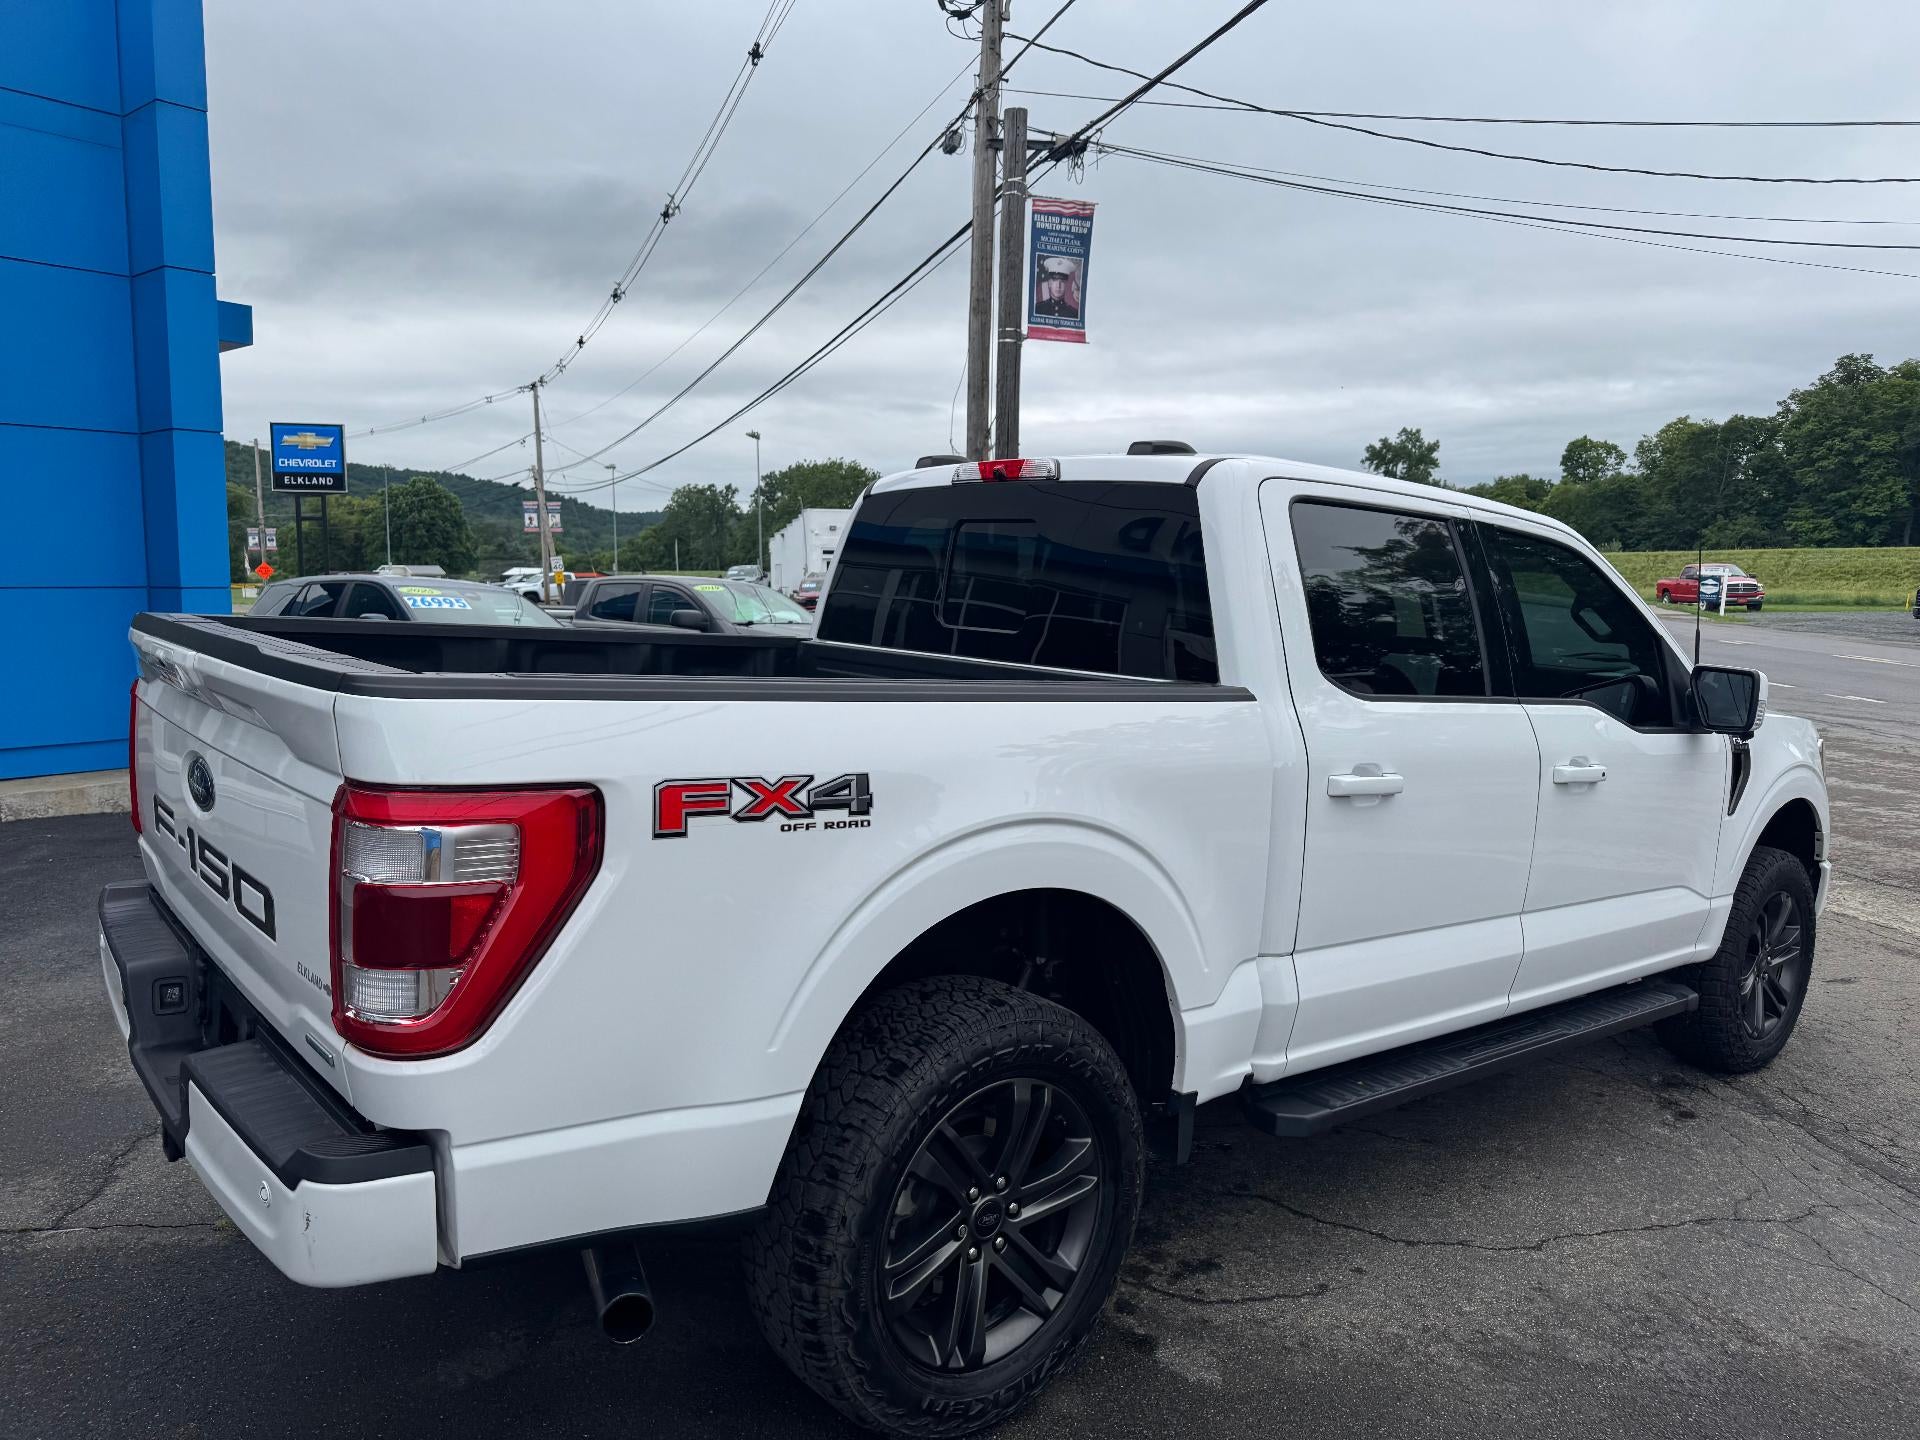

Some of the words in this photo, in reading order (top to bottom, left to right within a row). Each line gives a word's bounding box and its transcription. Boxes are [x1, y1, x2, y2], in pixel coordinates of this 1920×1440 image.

[279, 458, 337, 468] CHEVROLET
[284, 475, 334, 485] ELKLAND
[407, 595, 467, 608] 26995
[652, 772, 873, 840] FX4
[780, 822, 817, 832] OFF
[824, 819, 871, 830] ROAD
[153, 794, 277, 942] F-150
[297, 961, 323, 989] ELKLAND
